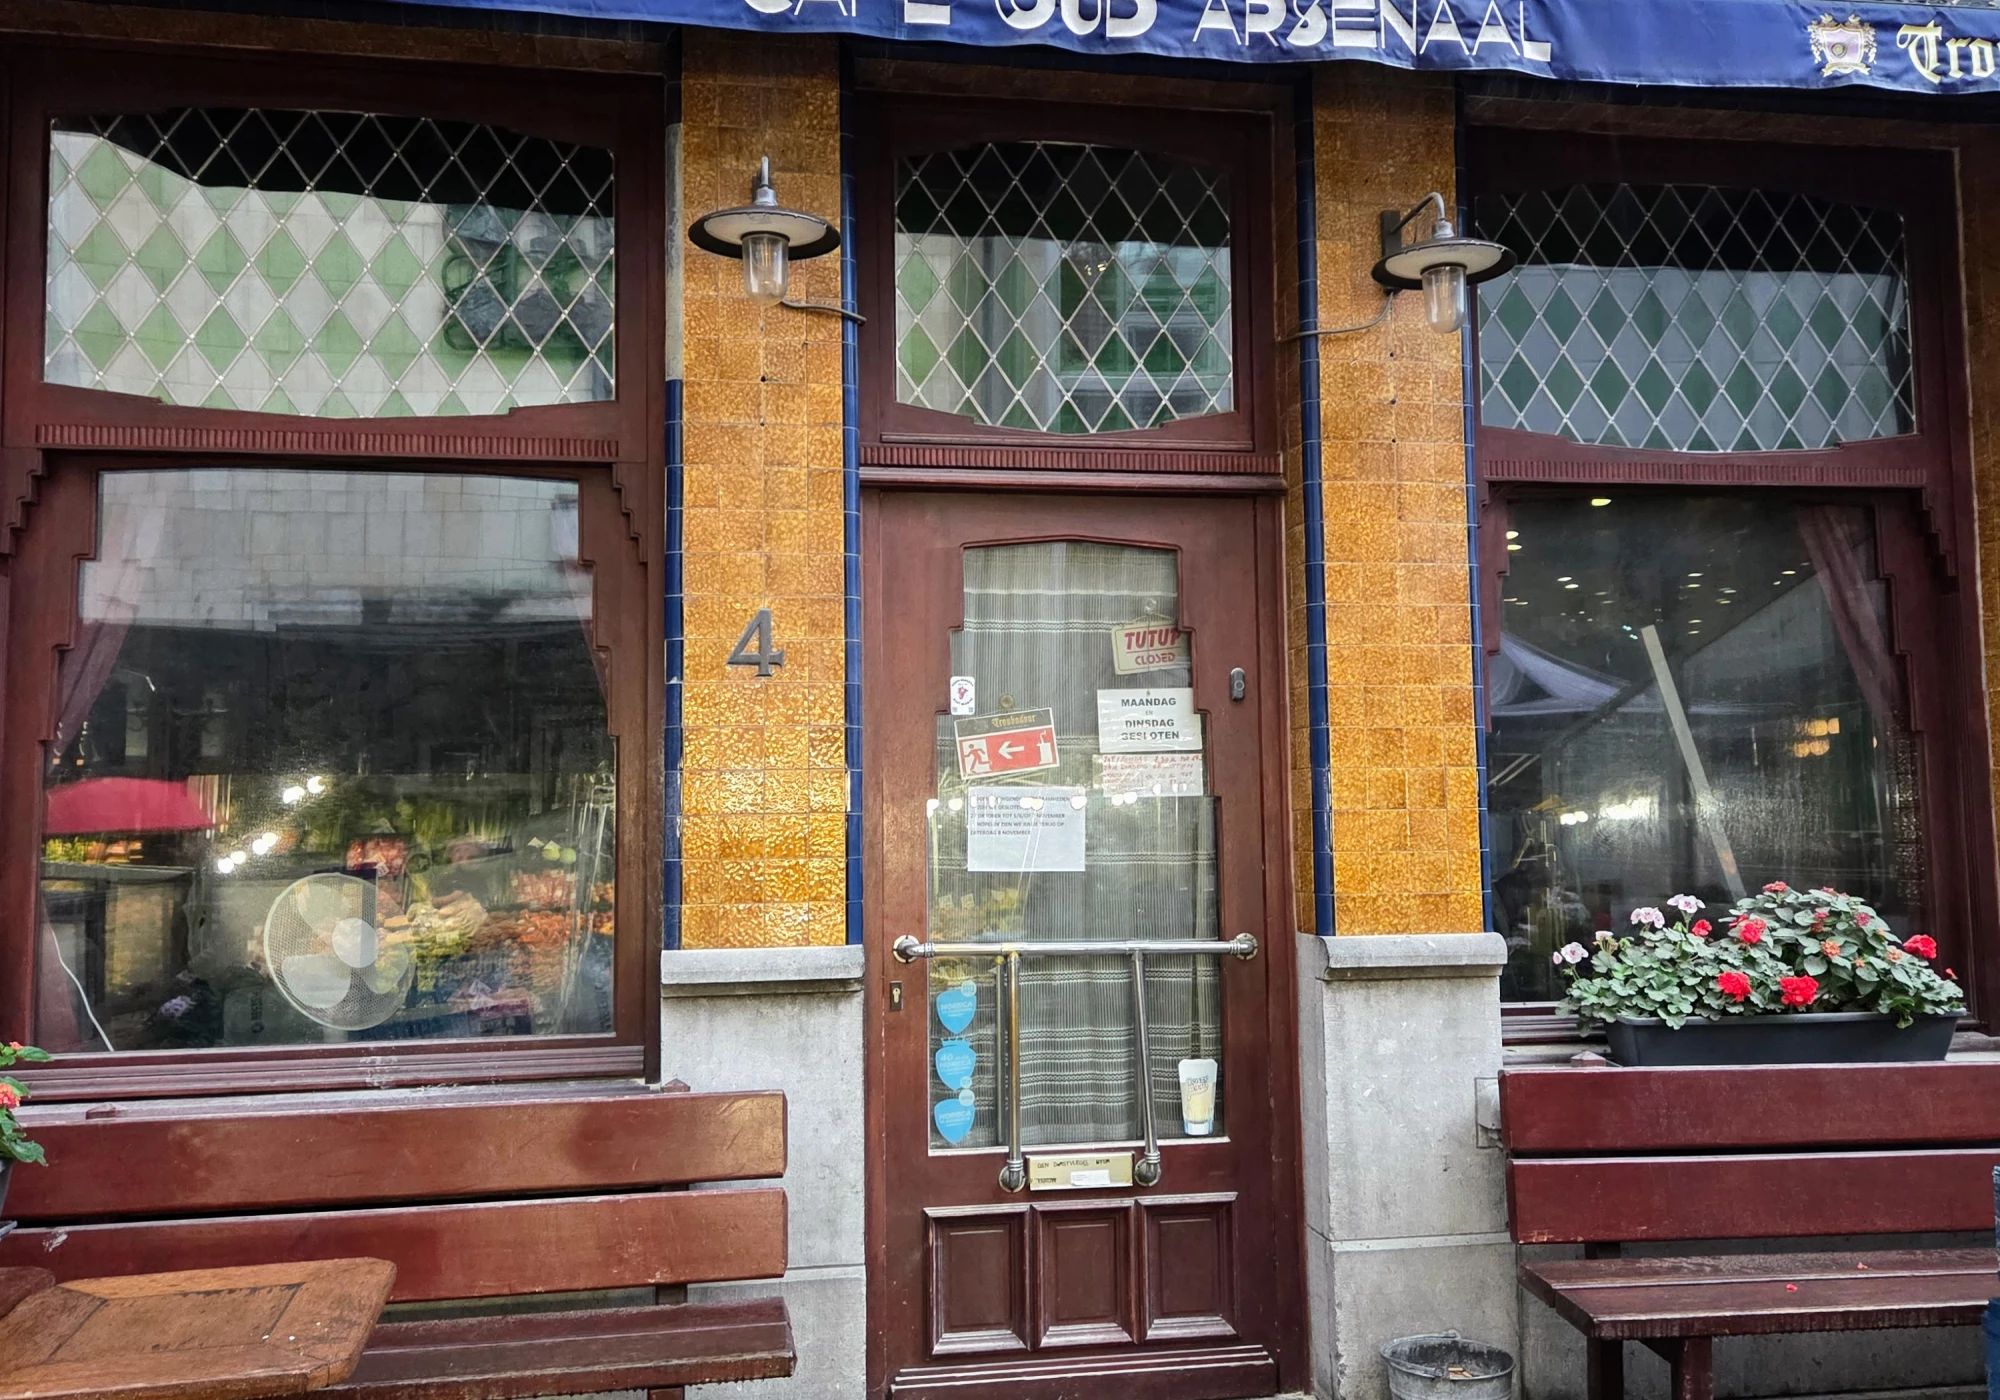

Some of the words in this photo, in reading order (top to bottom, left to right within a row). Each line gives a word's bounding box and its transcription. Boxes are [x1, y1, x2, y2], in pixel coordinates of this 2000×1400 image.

[1193, 0, 1552, 62] ARSENAAL
[1896, 20, 2000, 84] Tro
[726, 608, 784, 677] 4
[1124, 628, 1181, 650] TUTUP
[1135, 652, 1176, 665] CLOSED
[1121, 698, 1177, 707] MAANDAG
[991, 714, 1037, 728] Troubadour
[1125, 719, 1175, 728] DINSDAG
